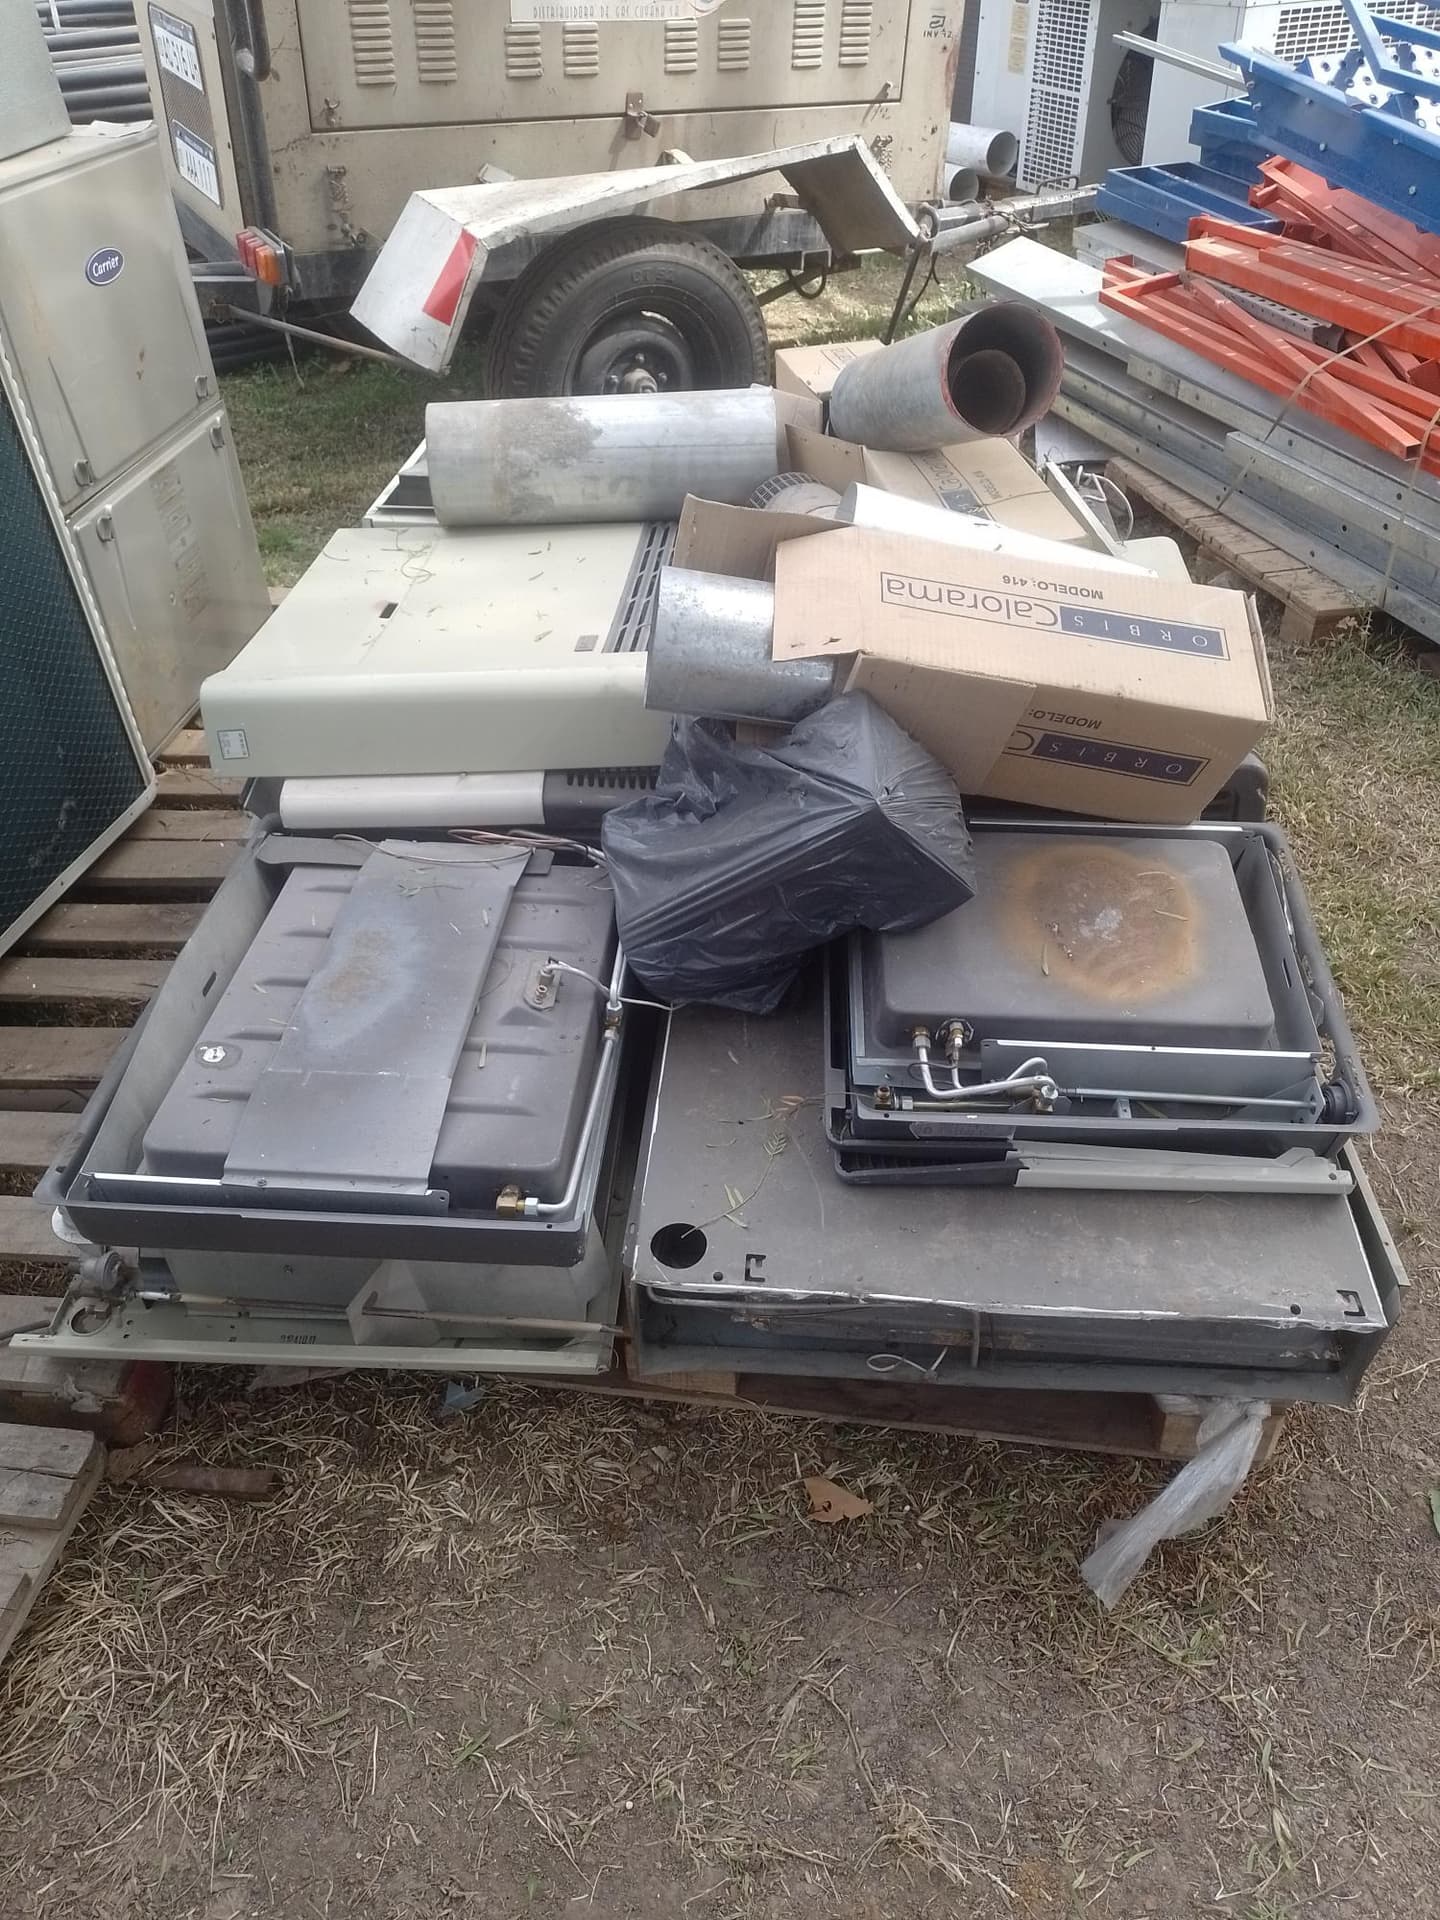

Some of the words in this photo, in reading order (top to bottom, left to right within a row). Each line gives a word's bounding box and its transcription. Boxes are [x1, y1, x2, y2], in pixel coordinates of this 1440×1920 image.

[600, 6, 609, 18] DE
[92, 256, 119, 277] Carrier
[1001, 575, 1029, 588] 416
[1033, 580, 1104, 601] MODELO:
[886, 578, 1059, 627] Calorama
[1074, 615, 1208, 648] ORBIS
[1028, 708, 1102, 730] MODELO:
[1050, 743, 1183, 774] ORBIS
